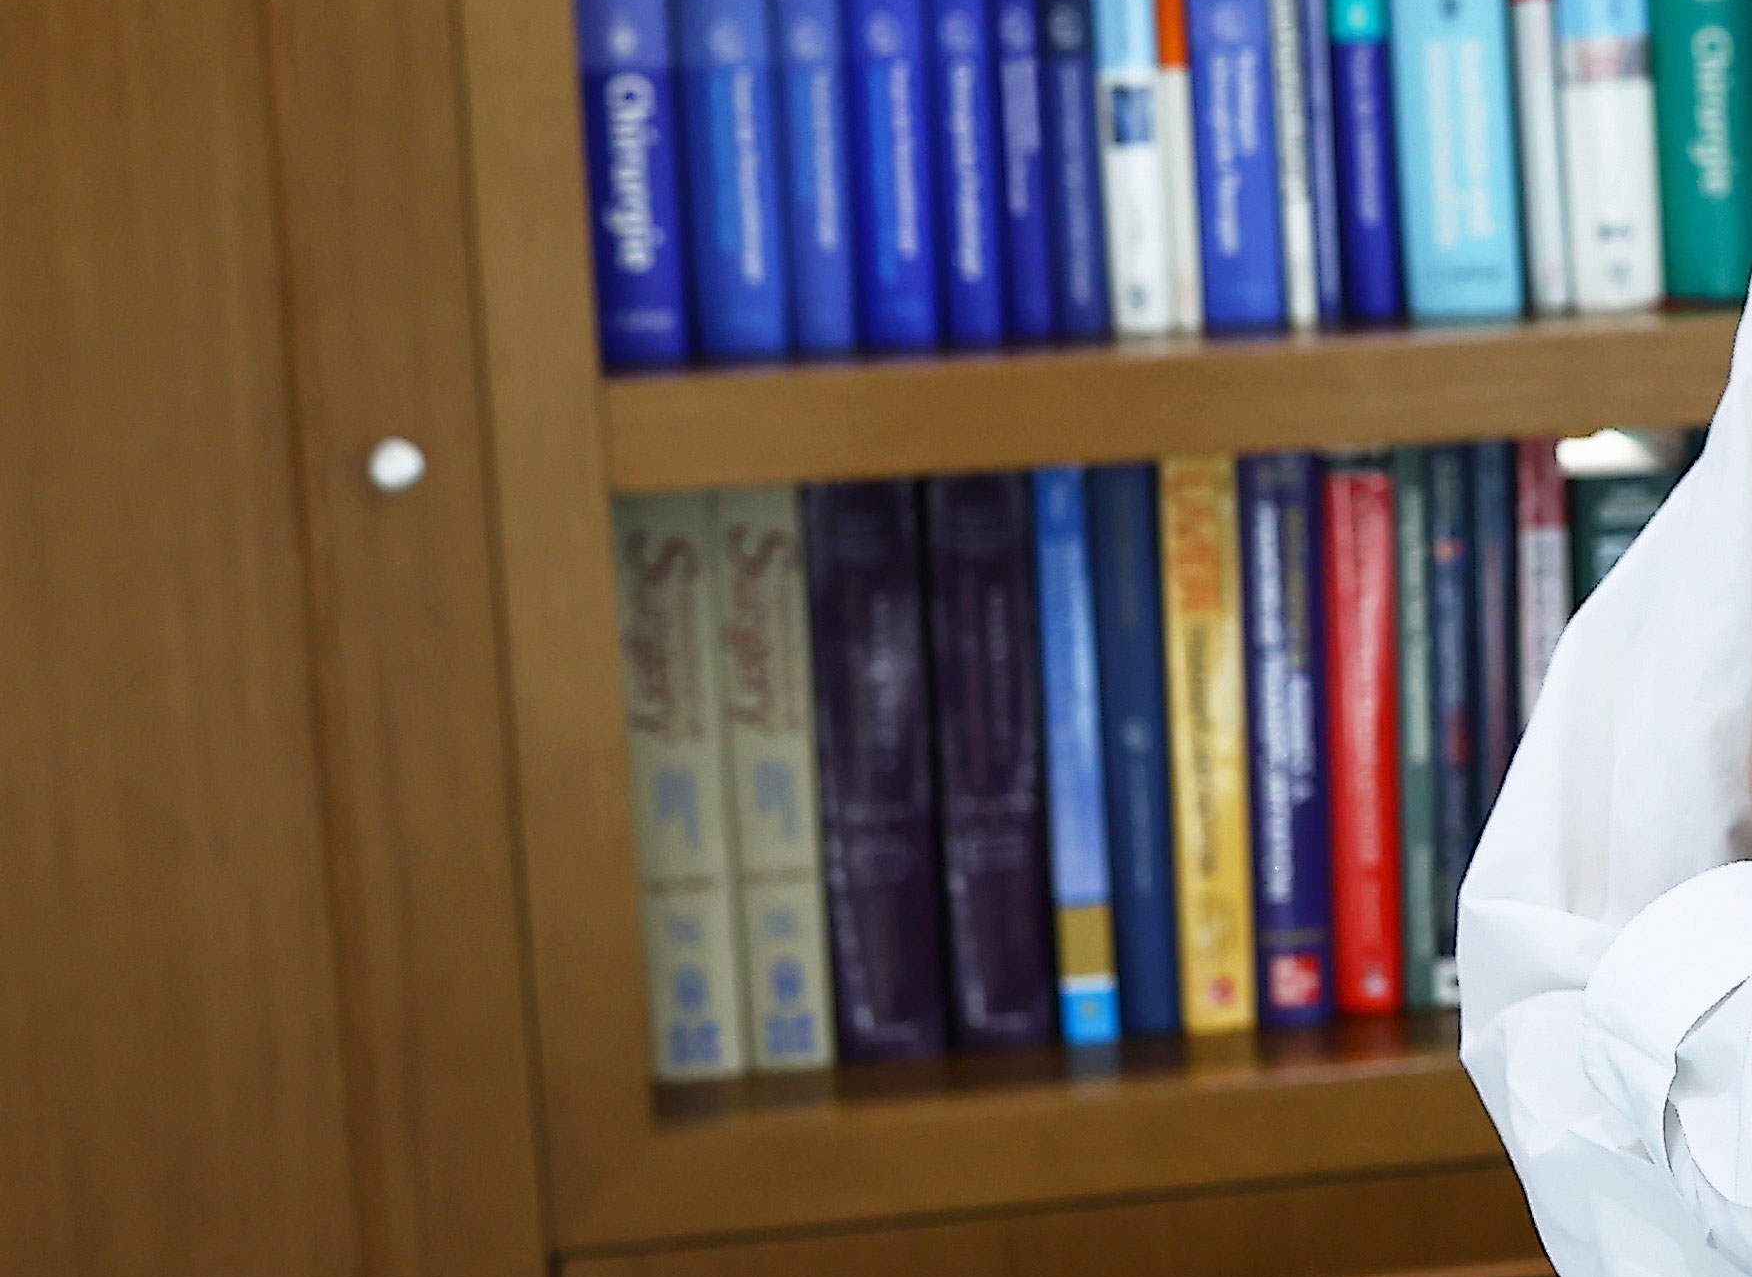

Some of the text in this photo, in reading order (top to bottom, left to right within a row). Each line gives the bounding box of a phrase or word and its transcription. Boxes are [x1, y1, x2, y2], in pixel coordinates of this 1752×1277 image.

[602, 71, 666, 275] Chirurgie
[1687, 24, 1740, 200] Chirurgie
[622, 527, 699, 735] Surgery
[718, 523, 800, 727] Surgery
